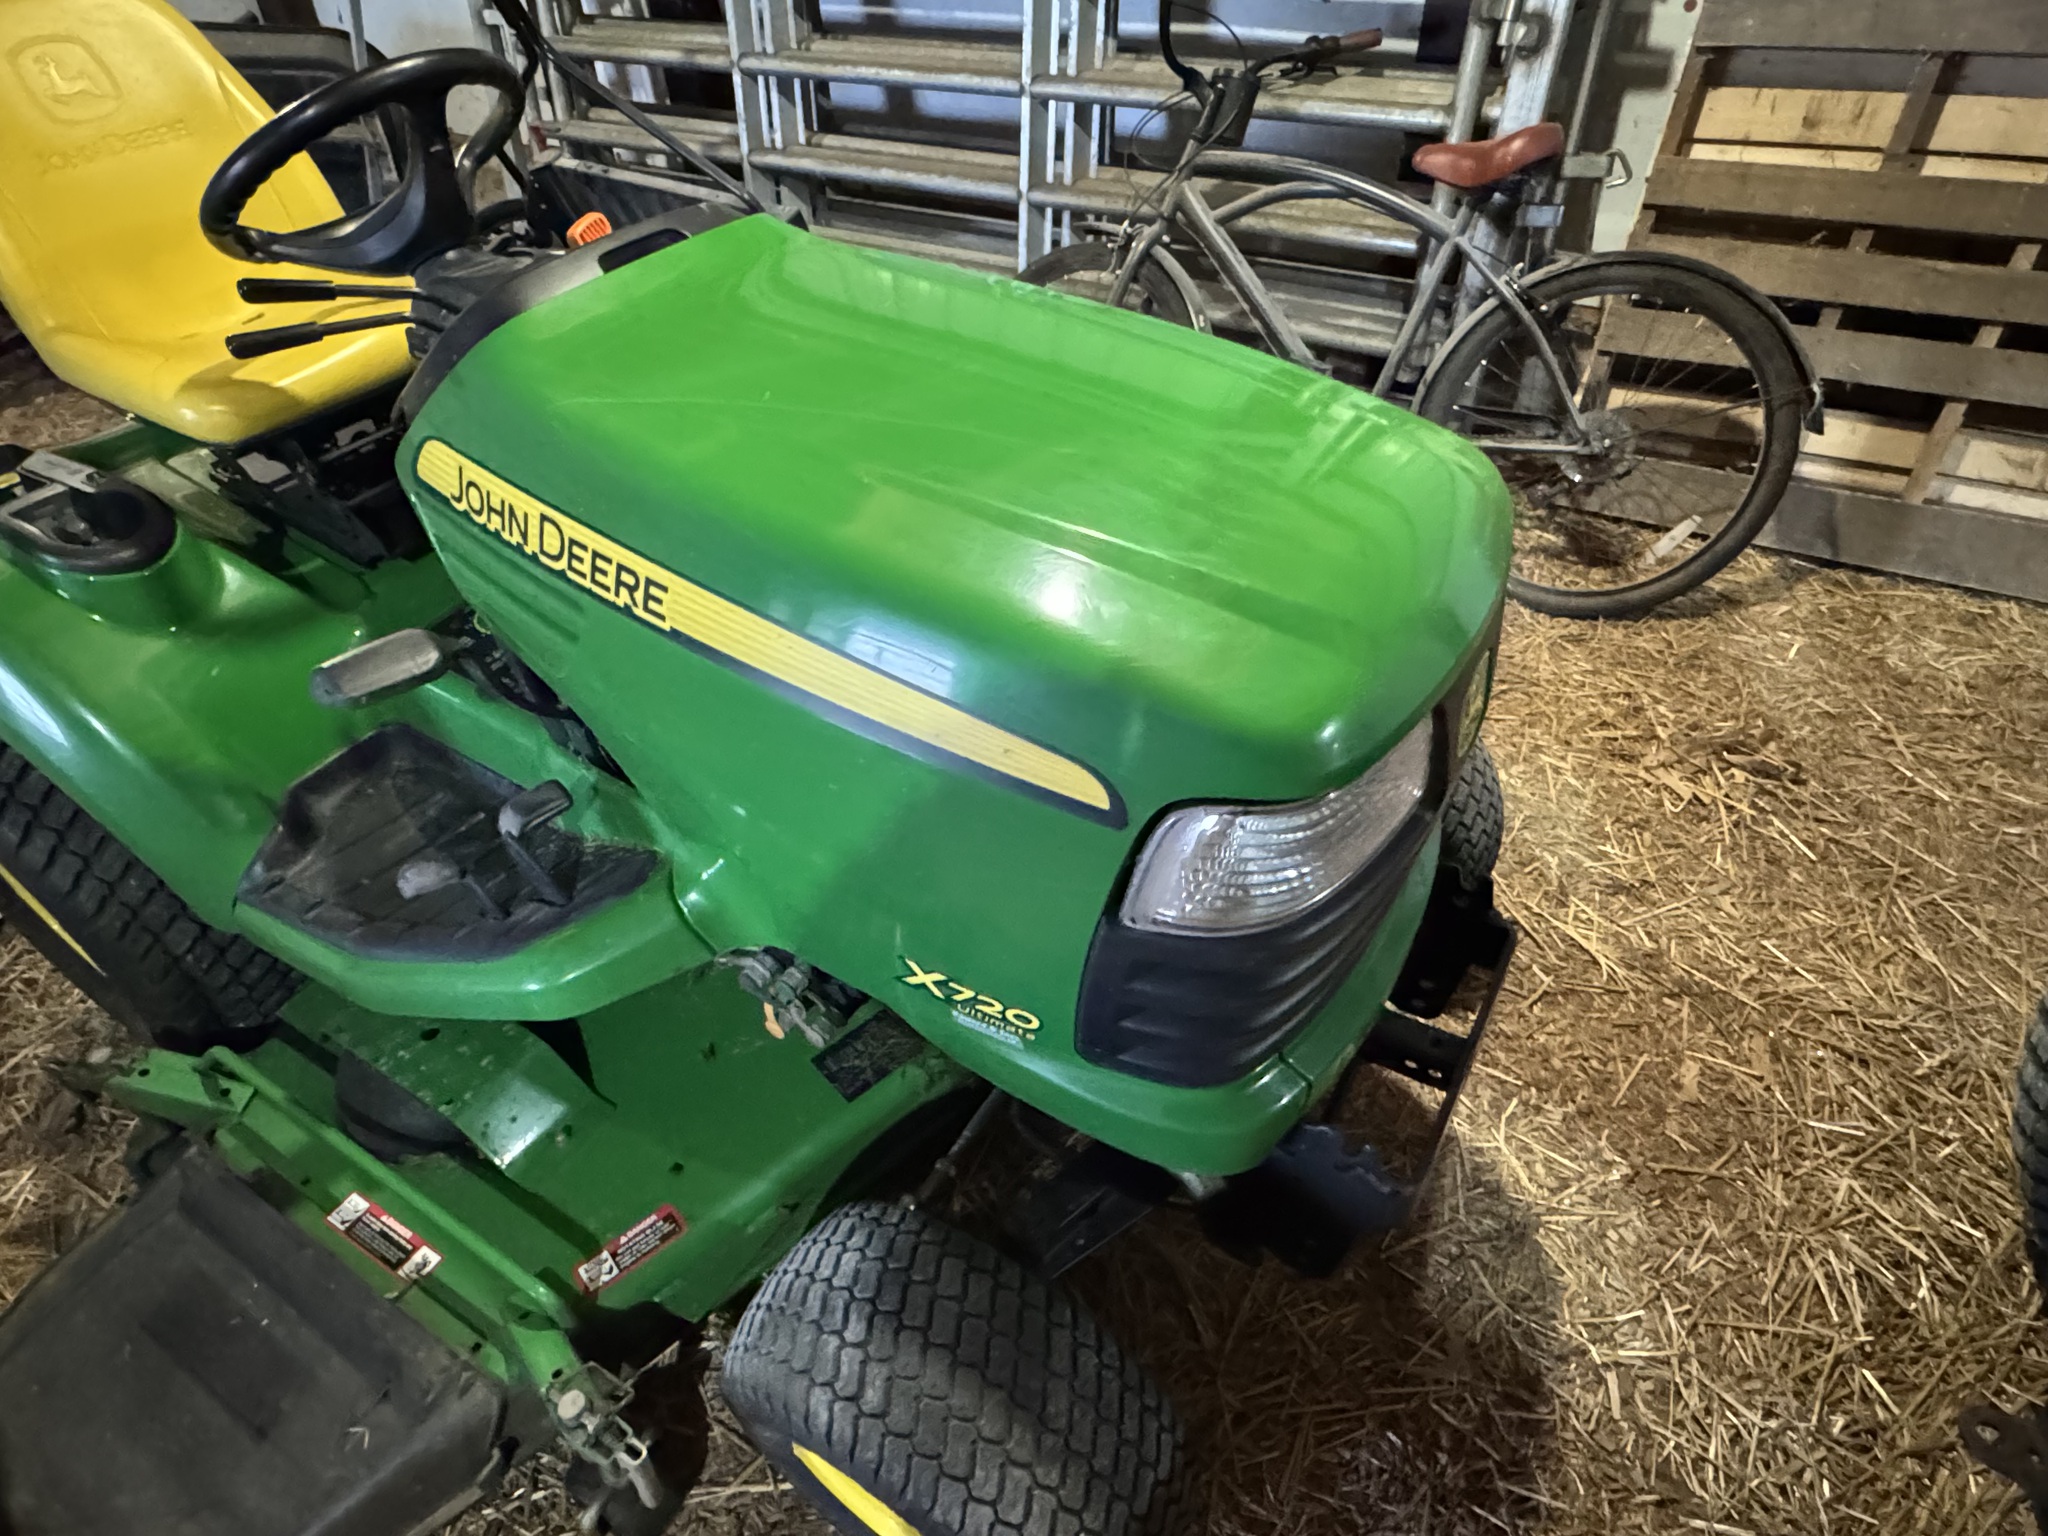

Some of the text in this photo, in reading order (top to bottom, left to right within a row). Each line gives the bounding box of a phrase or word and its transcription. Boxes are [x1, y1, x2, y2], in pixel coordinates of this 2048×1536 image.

[450, 465, 669, 624] JOHN DEERE
[901, 957, 1041, 1030] X720
